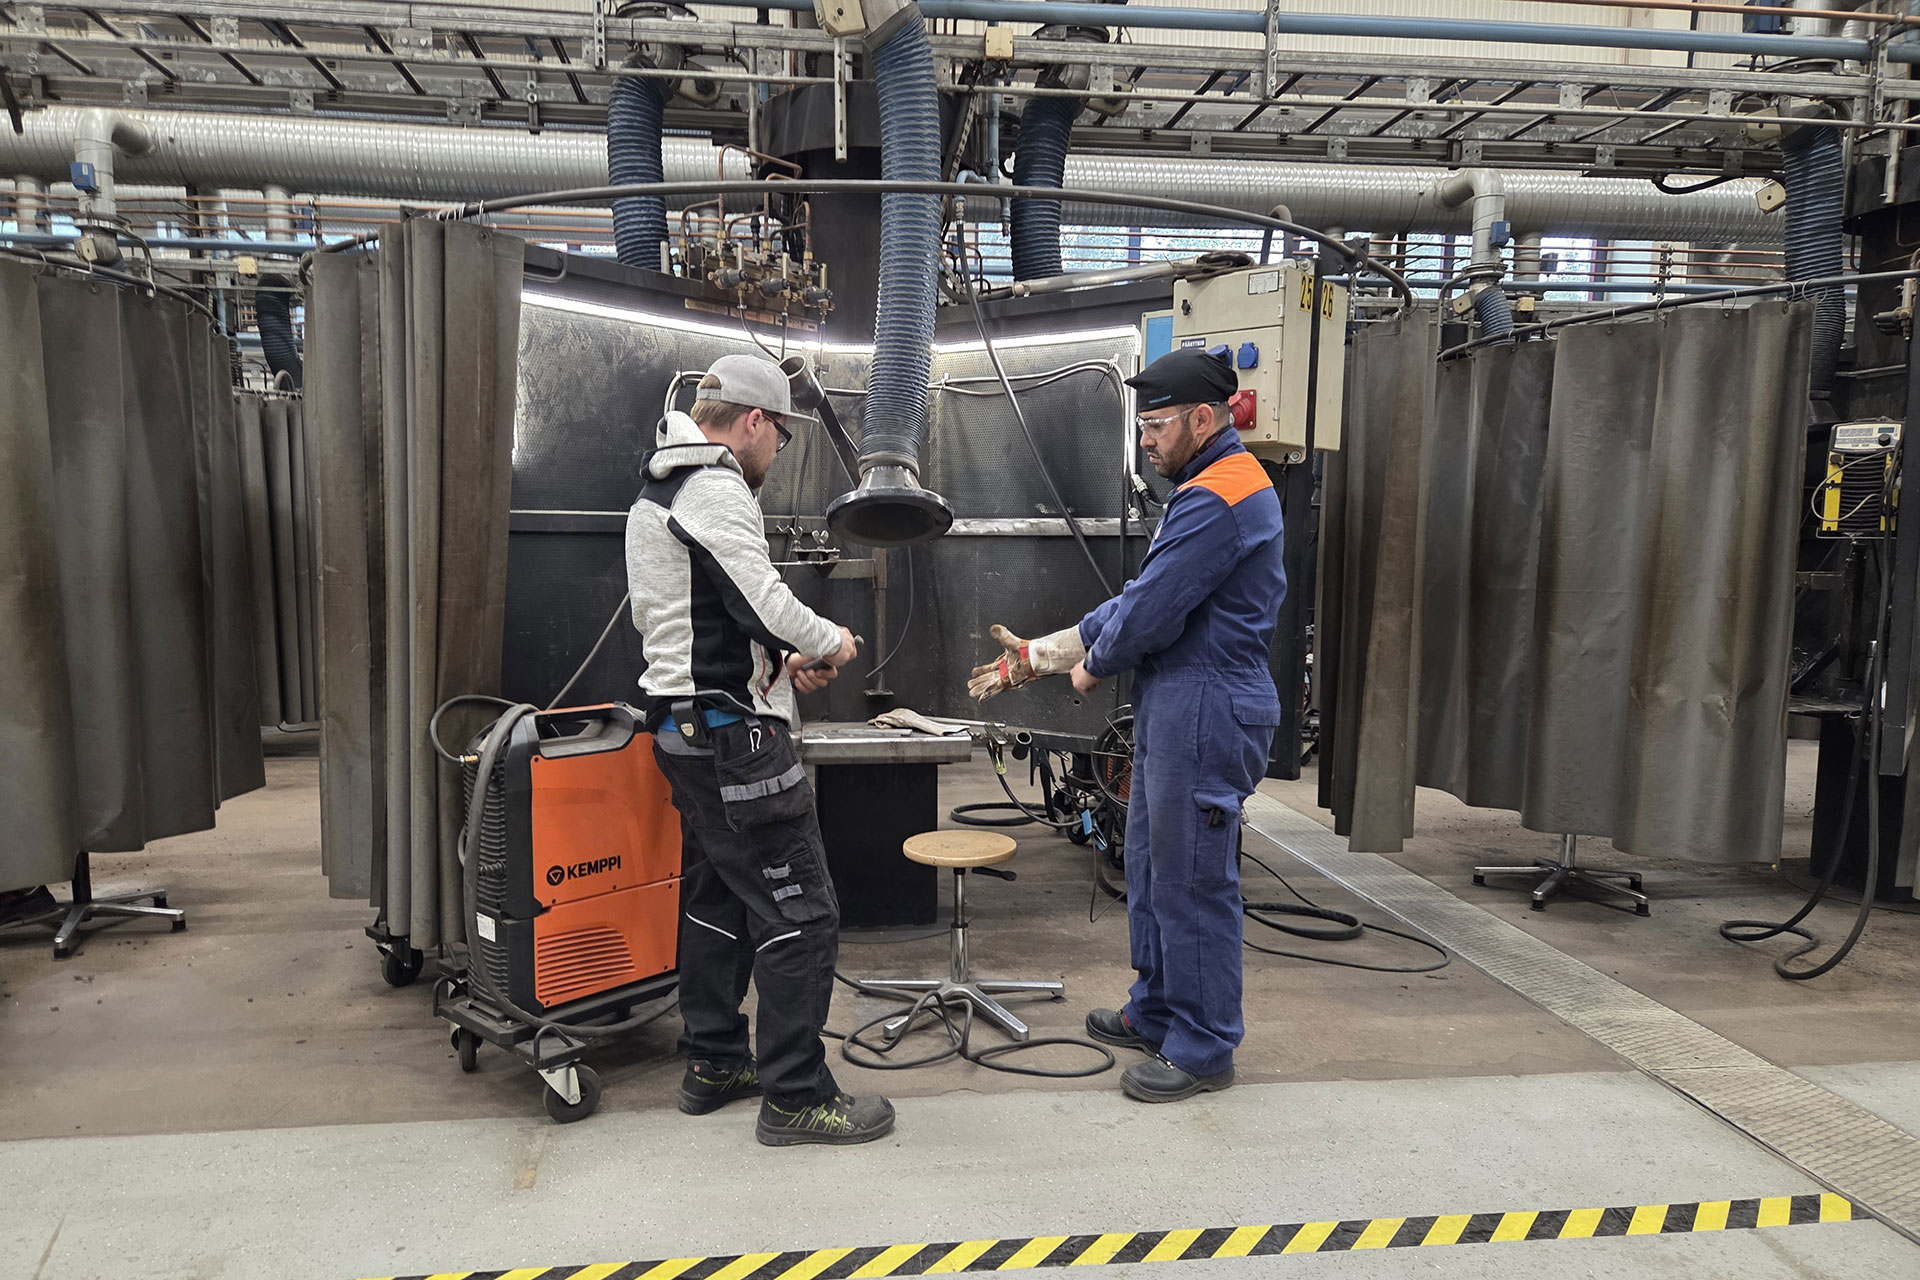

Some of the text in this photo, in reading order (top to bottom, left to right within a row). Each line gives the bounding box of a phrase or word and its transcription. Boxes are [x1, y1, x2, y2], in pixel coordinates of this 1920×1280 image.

[1300, 275, 1312, 310] 25
[1322, 284, 1334, 318] 26
[567, 855, 621, 880] KEMPPI
